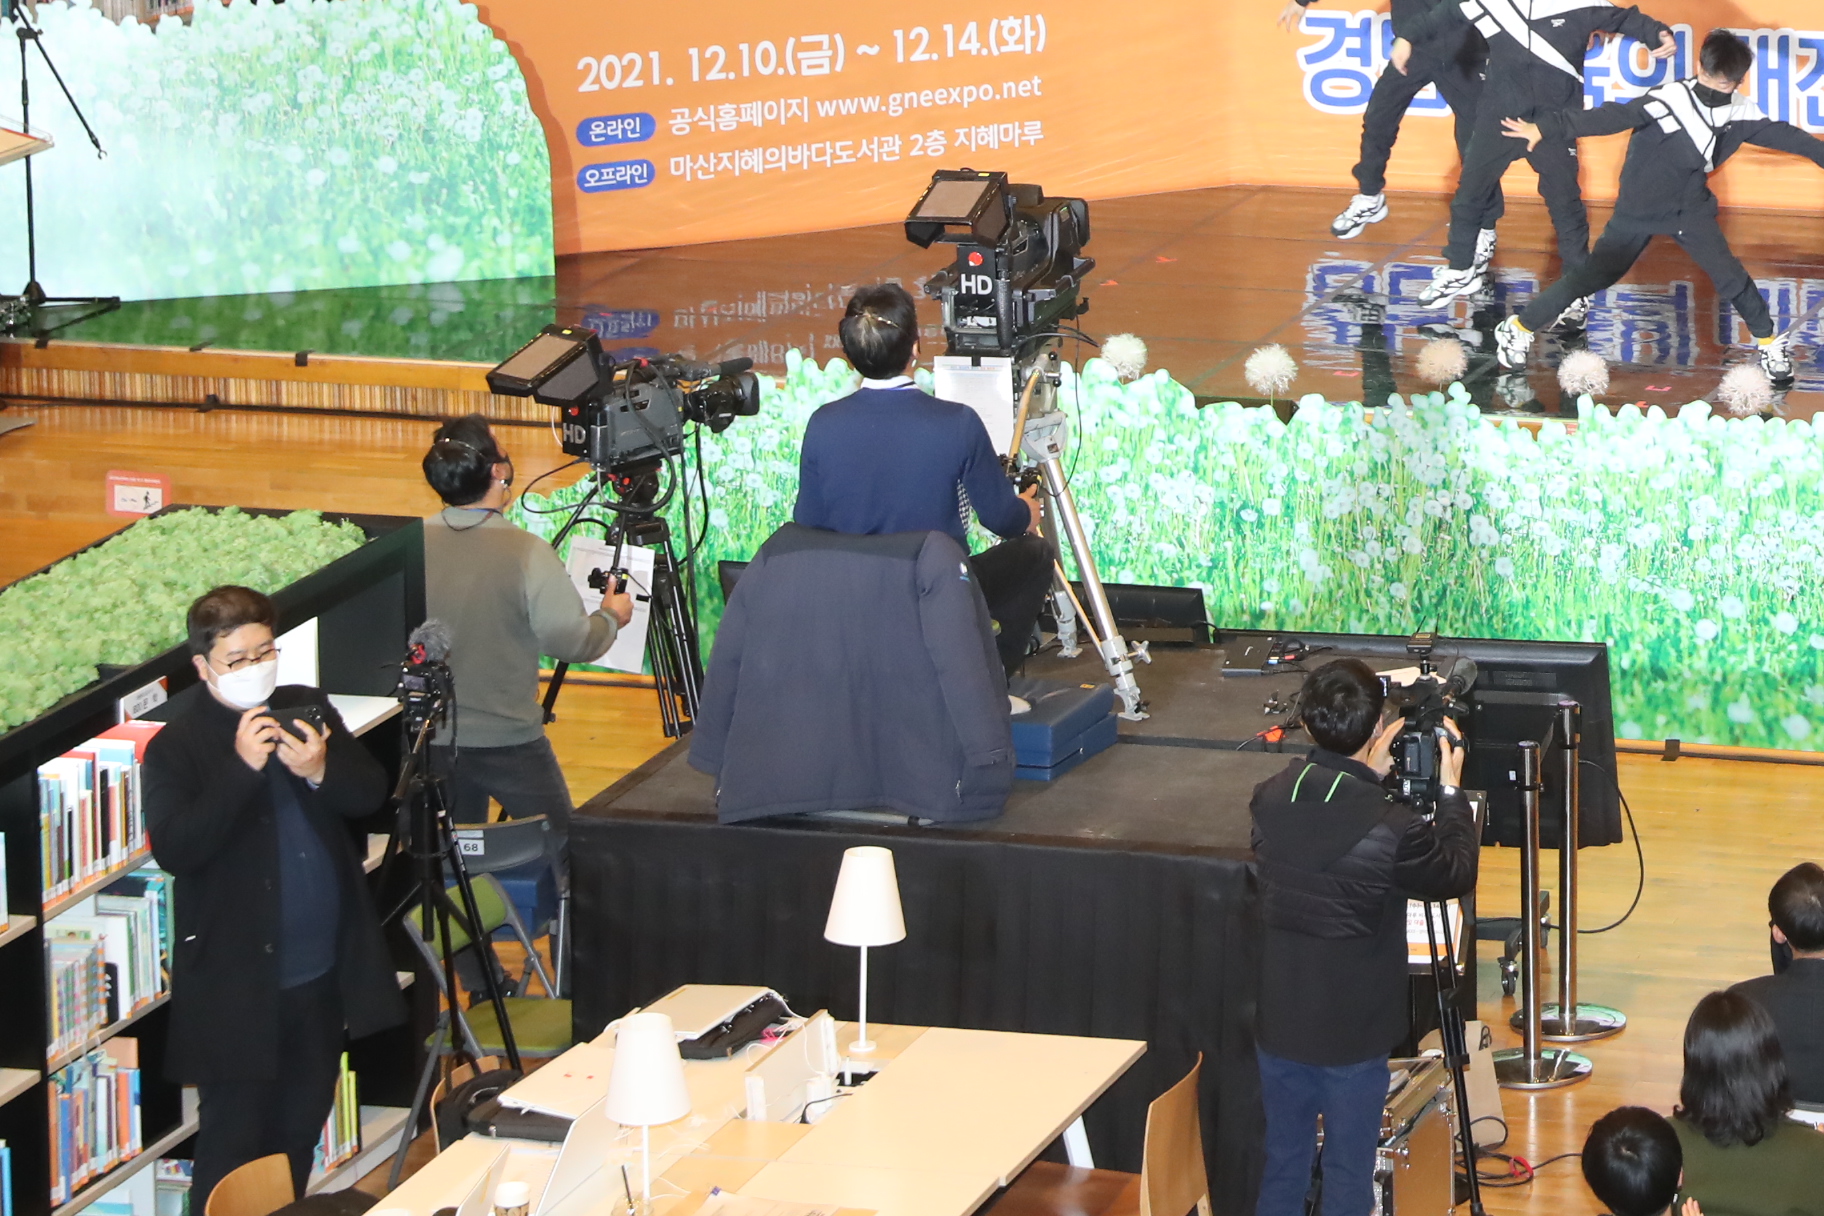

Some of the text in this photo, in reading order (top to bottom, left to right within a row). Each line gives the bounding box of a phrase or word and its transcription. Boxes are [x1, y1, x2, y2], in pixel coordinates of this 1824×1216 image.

[577, 52, 674, 93] 2021.
[688, 33, 845, 82] 12.10.(금)
[893, 14, 1047, 64] 12.14.(화)
[668, 76, 1042, 136] 공식홈페이지 www.gneexpo.net
[589, 117, 642, 142] 온라인
[670, 120, 1044, 182] 마산지혜의바다도서관 2층 지혜마루
[584, 162, 649, 189] 오프라인
[961, 274, 993, 295] HD
[563, 422, 586, 445] HD
[464, 844, 478, 852] 68
